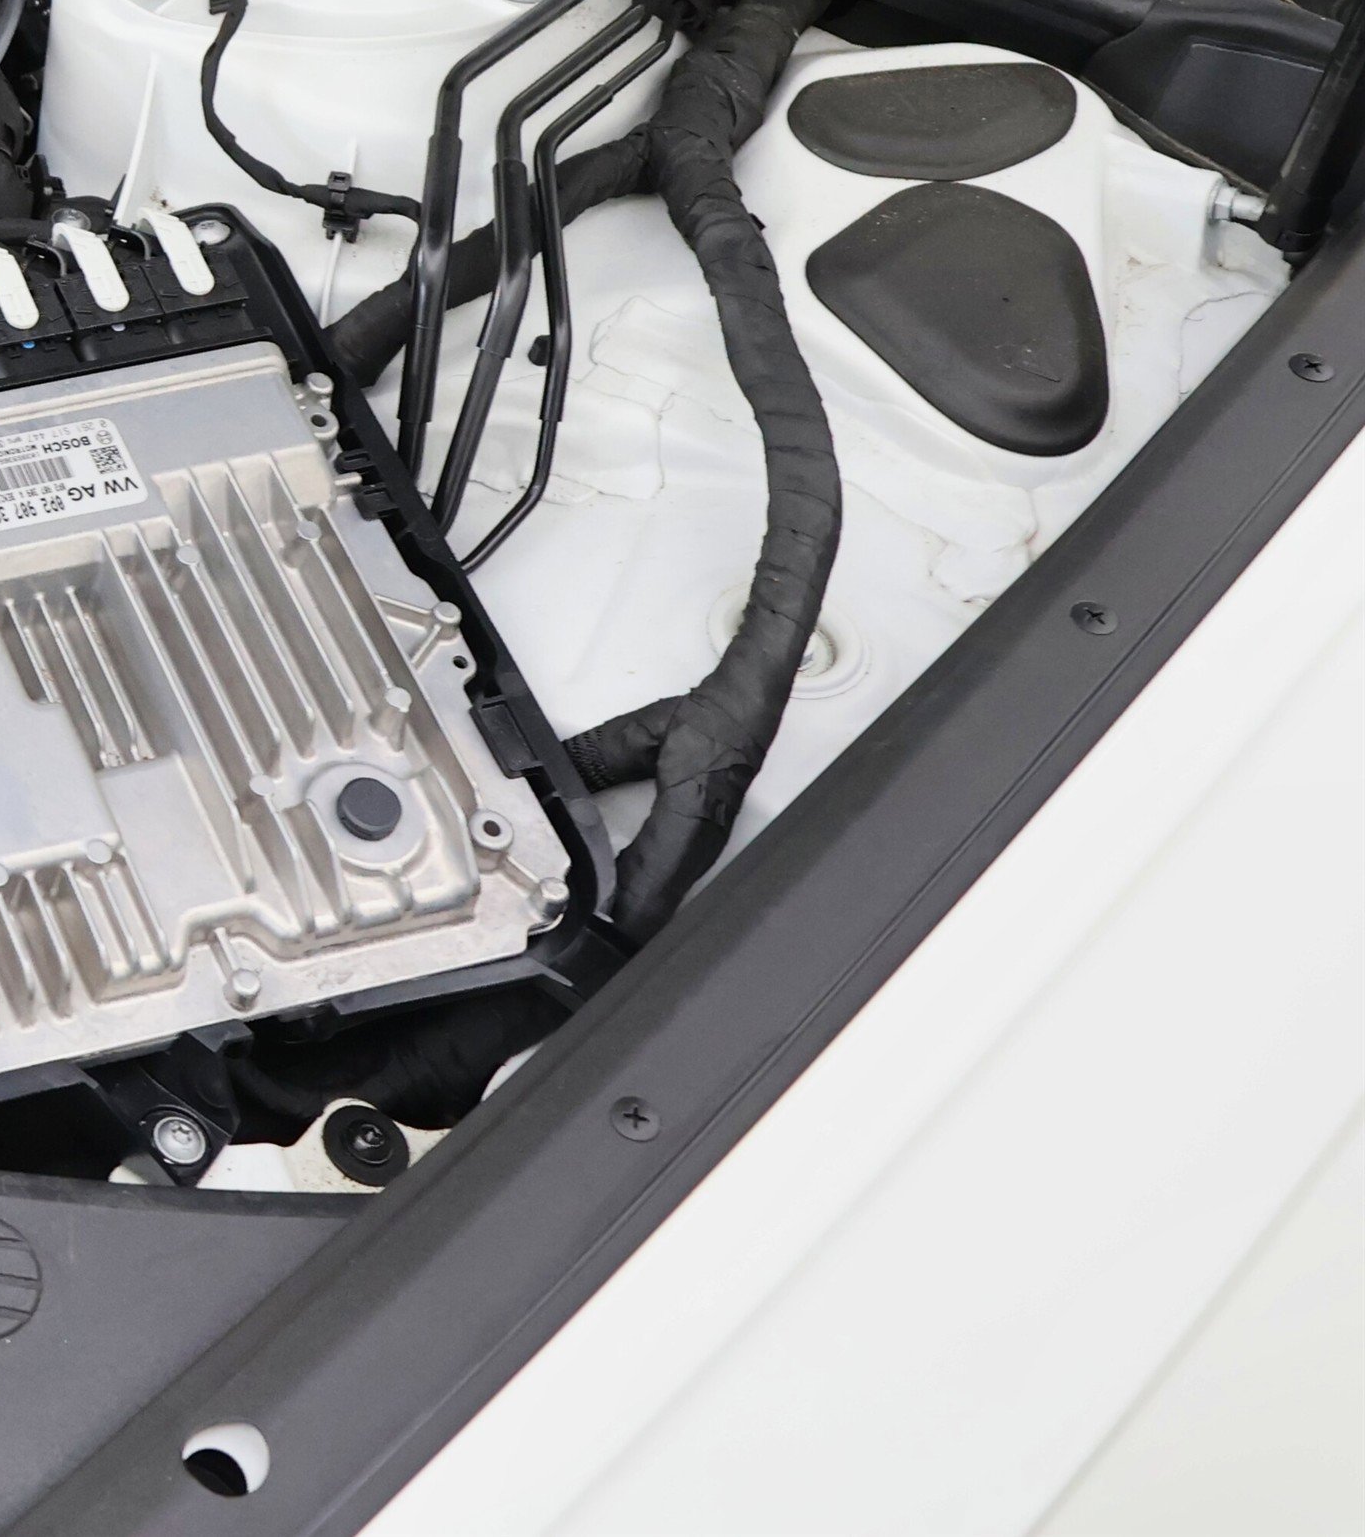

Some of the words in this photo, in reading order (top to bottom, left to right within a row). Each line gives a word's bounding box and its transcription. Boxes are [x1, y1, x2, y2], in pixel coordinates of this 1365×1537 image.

[40, 435, 91, 453] BOSCH
[65, 483, 99, 502] AG
[99, 475, 138, 495] VW
[11, 500, 38, 519] 907
[39, 494, 66, 513] 0P2
